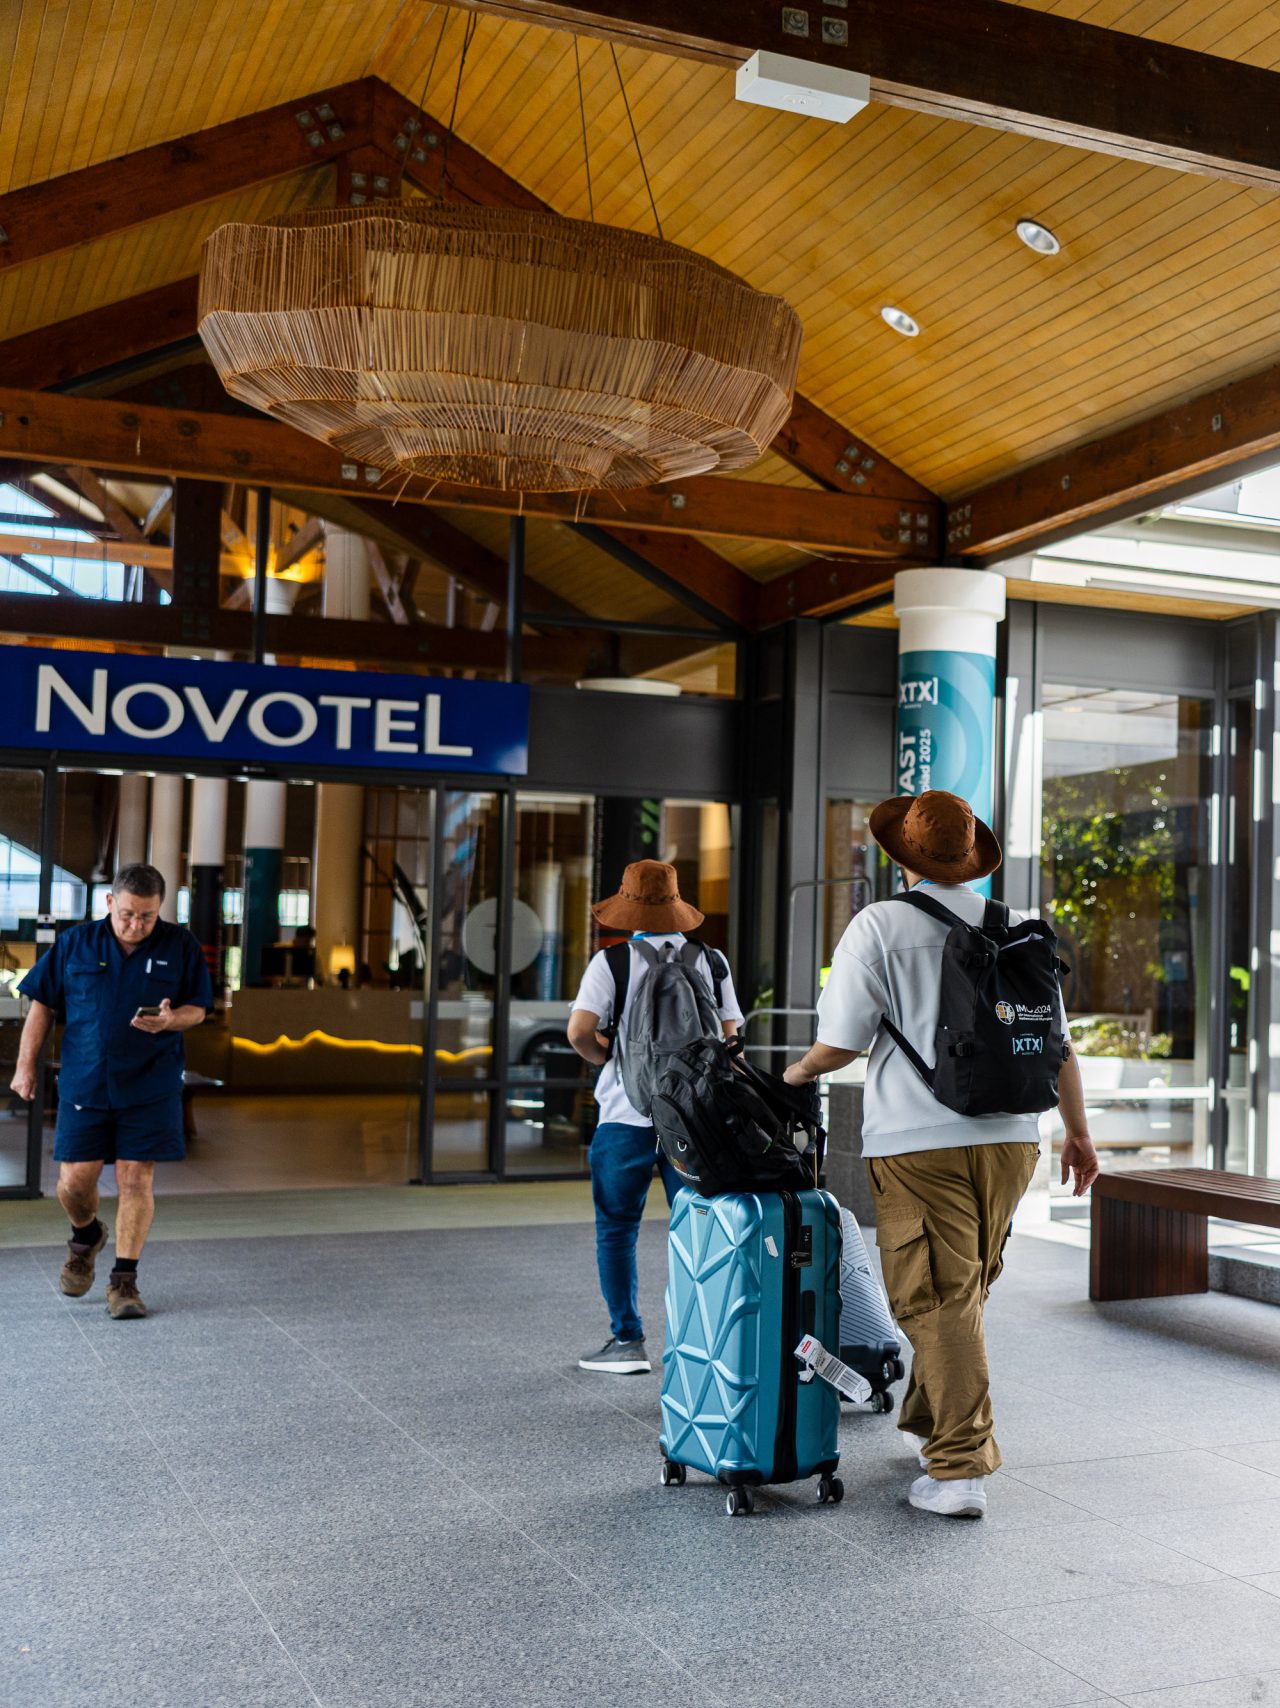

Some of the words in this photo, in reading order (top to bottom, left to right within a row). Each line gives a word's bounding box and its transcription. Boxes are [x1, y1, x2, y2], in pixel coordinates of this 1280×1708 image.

[35, 664, 473, 757] NOVOTEL
[899, 731, 917, 797] AST
[919, 728, 931, 763] 2025
[1012, 1036, 1043, 1054] [XTX]
